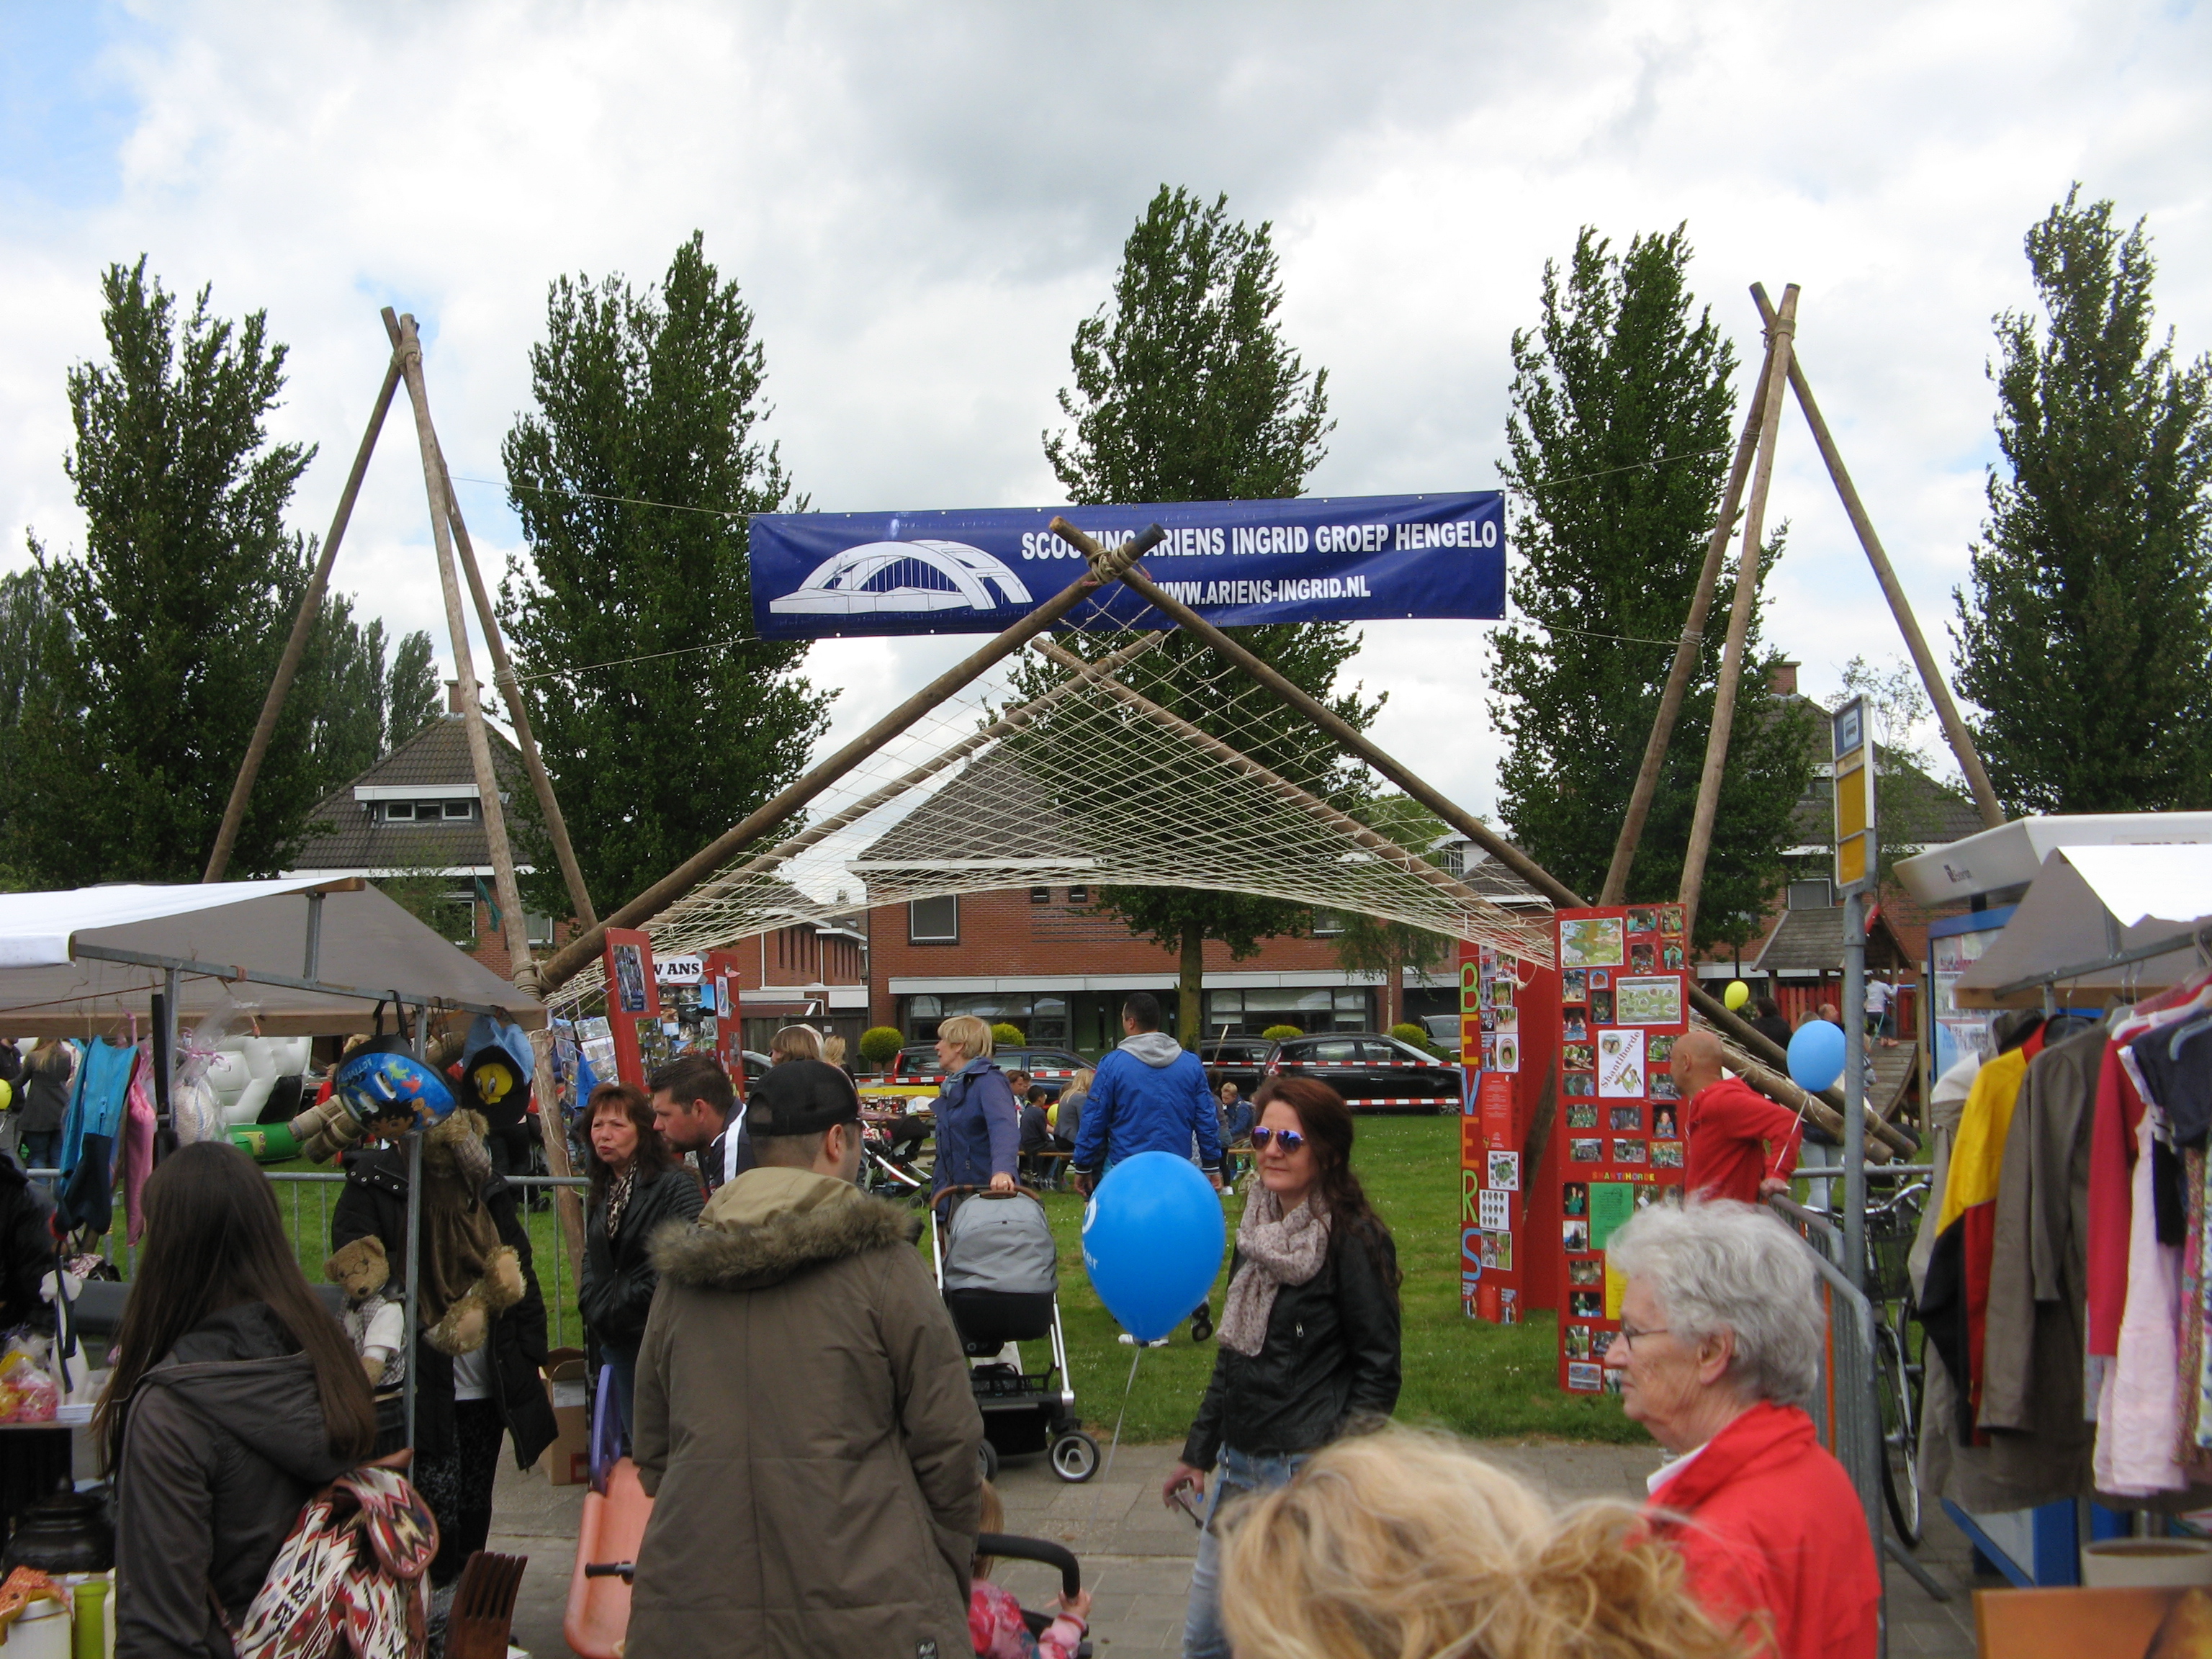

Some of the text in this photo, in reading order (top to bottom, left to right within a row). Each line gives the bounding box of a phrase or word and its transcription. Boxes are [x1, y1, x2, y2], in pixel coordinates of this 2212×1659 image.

[1232, 526, 1308, 554] INGRID
[1316, 523, 1389, 553] GROEP
[1395, 520, 1497, 551] HENGELO
[1601, 1031, 1640, 1088] Shantihorde
[1460, 962, 1483, 1281] BEVERS
